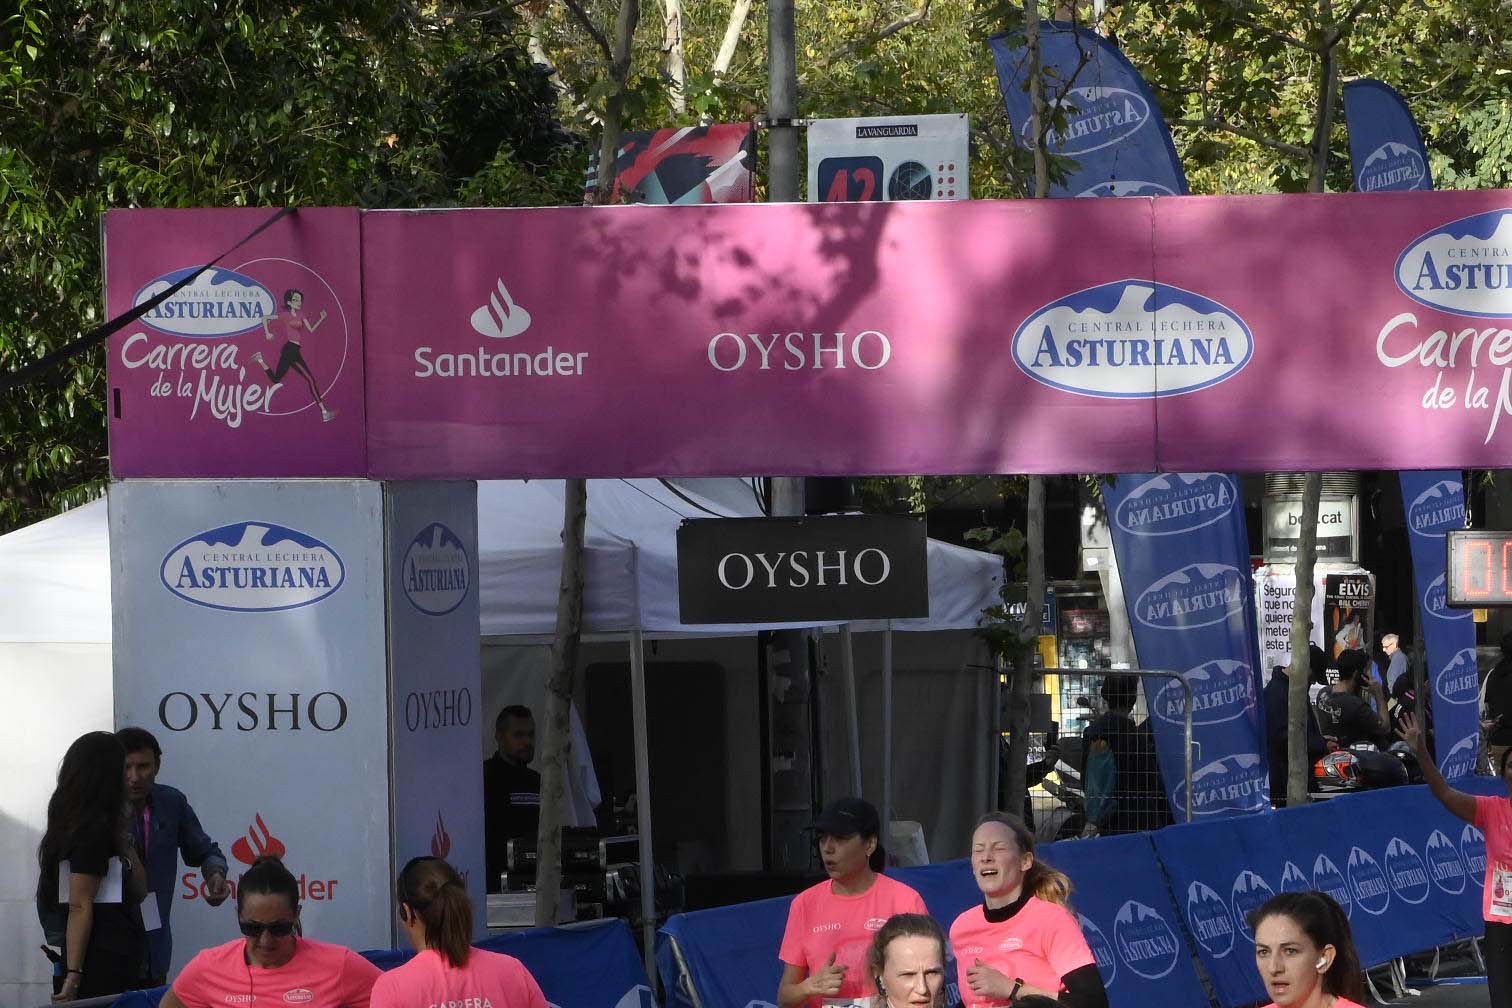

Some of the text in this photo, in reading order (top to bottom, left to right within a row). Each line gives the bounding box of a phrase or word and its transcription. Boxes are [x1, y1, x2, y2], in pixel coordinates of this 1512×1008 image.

[867, 125, 917, 136] VANGUARDIA
[146, 291, 264, 319] ASTURIANA
[1031, 324, 1235, 368] ASTURIANA
[1068, 319, 1227, 335] CENTRAL LECHERA
[121, 332, 239, 370] Carrera
[414, 346, 589, 379] Santander
[707, 330, 892, 371] OYSHO
[151, 366, 283, 428] de la Mujer
[1422, 371, 1456, 409] de
[1464, 369, 1489, 409] la
[176, 548, 331, 590] ASTURIANA
[203, 552, 325, 562] CENTRAL LECHERA
[718, 549, 891, 590] OYSHO
[1265, 600, 1281, 612] que
[1339, 583, 1370, 596] ELVIS
[1266, 641, 1285, 650] este
[158, 691, 348, 732] OYSHO
[405, 687, 472, 732] OYSHO
